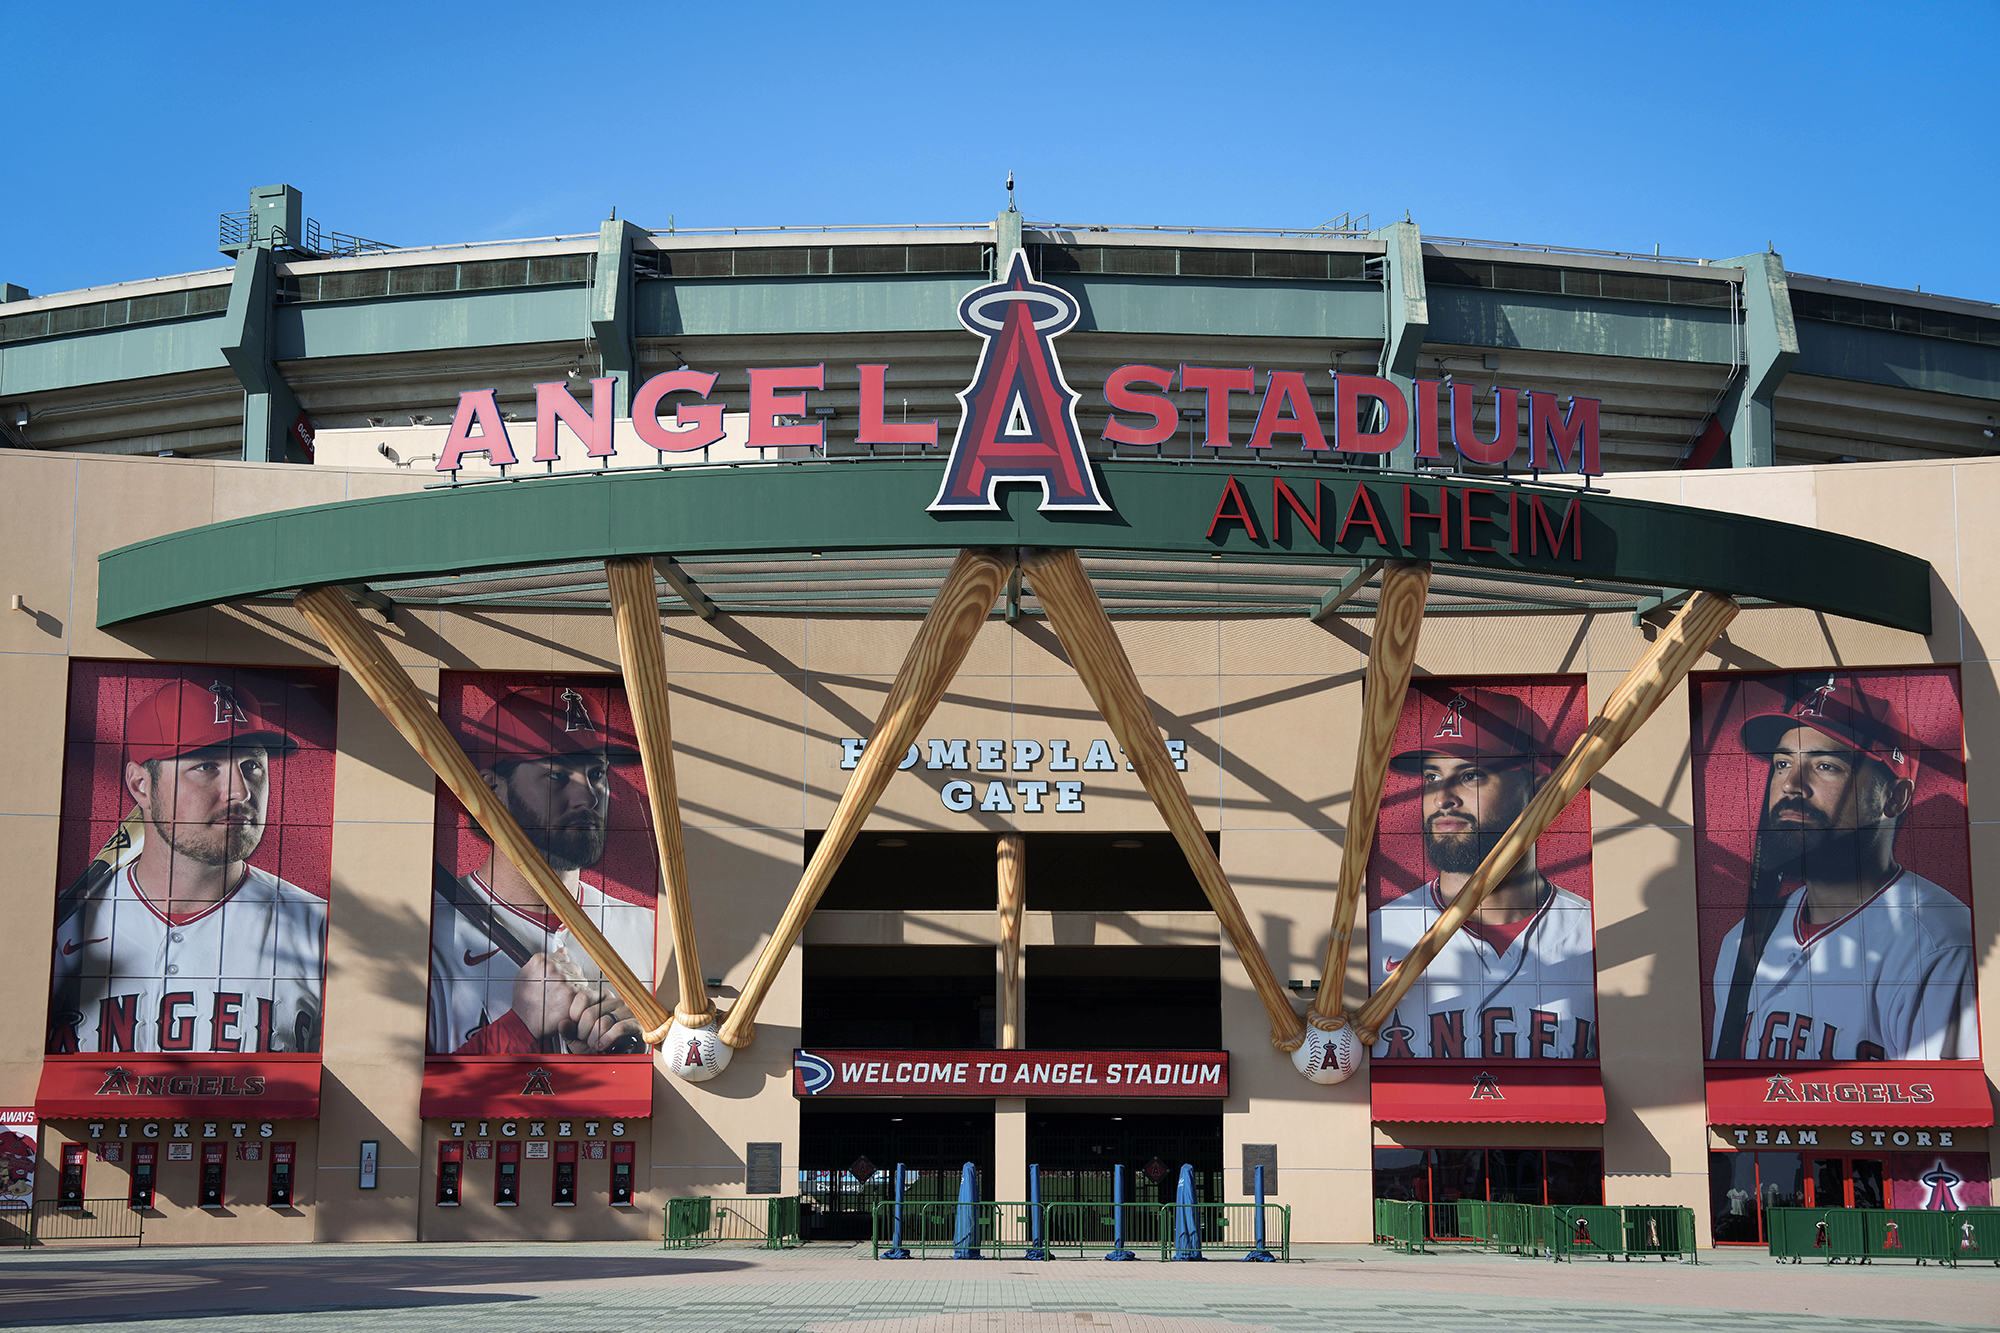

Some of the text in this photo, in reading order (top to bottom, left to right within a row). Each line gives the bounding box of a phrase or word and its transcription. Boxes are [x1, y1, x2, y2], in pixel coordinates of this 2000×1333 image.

[434, 362, 1603, 477] ANGEL STADIUM
[1205, 474, 1582, 561] ANAHEIM
[940, 780, 1084, 812] GATE
[95, 1066, 266, 1096] ANGELS
[841, 1063, 1221, 1084] WELCOME TO ANGEL STADIUM
[1763, 1073, 1935, 1103] ANGELS
[0, 1111, 35, 1123] AWAYS
[450, 1122, 626, 1137] TICKETS
[88, 1122, 274, 1138] TICKETS
[1734, 1129, 1954, 1147] TEAM STORE
